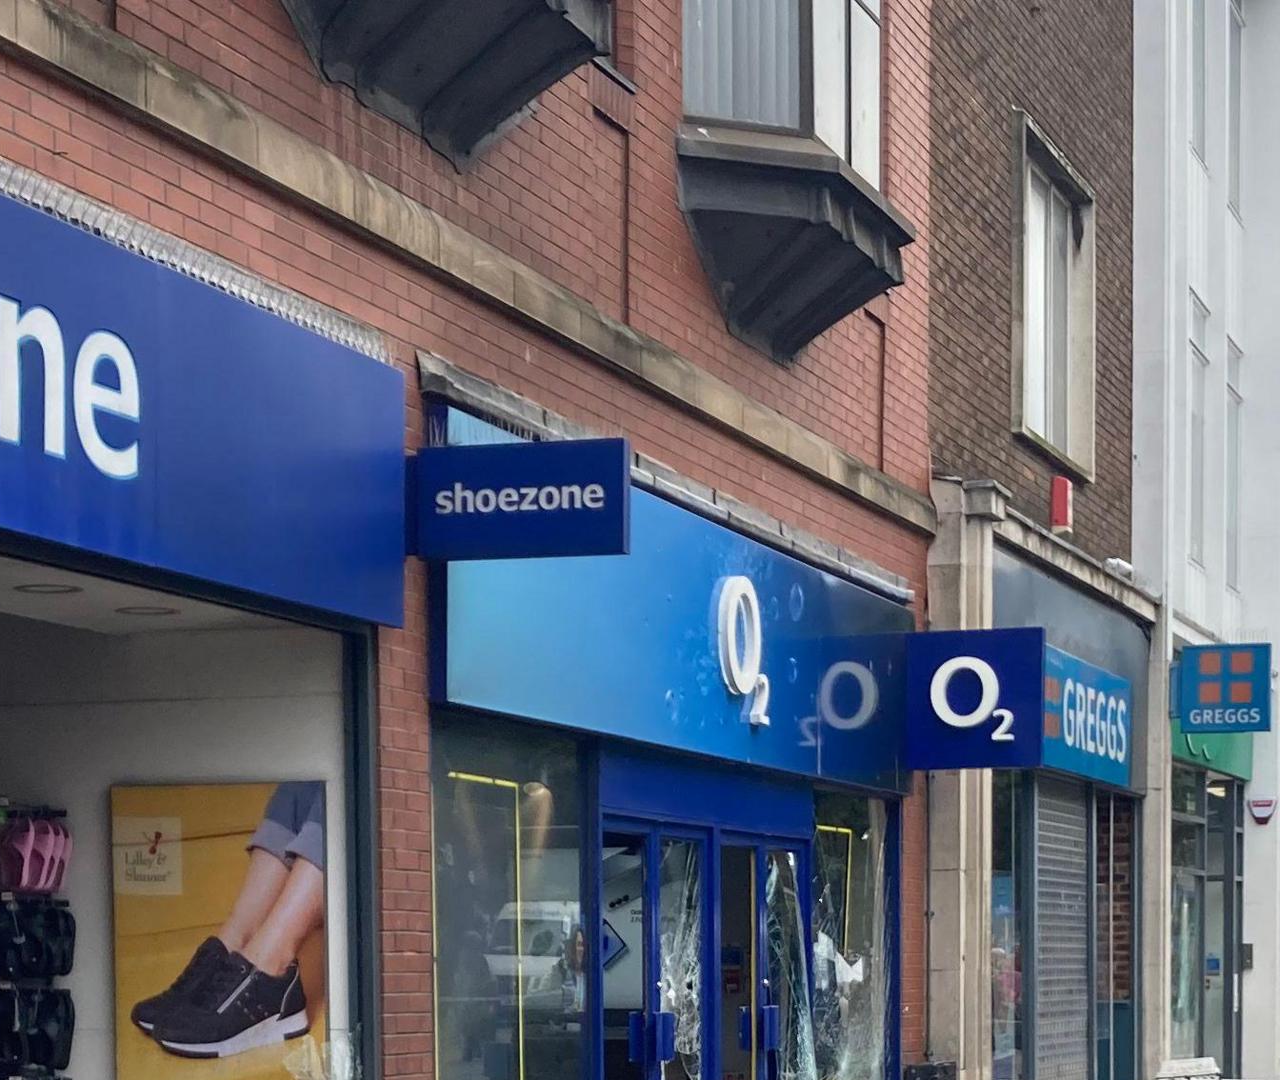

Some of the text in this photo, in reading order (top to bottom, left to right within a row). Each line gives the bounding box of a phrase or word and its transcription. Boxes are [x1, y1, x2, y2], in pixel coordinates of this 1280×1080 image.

[435, 482, 605, 514] shoezone
[717, 575, 770, 727] O2
[929, 656, 1015, 742] O2
[1062, 677, 1128, 764] GREGGS
[1189, 708, 1261, 725] GREGGS
